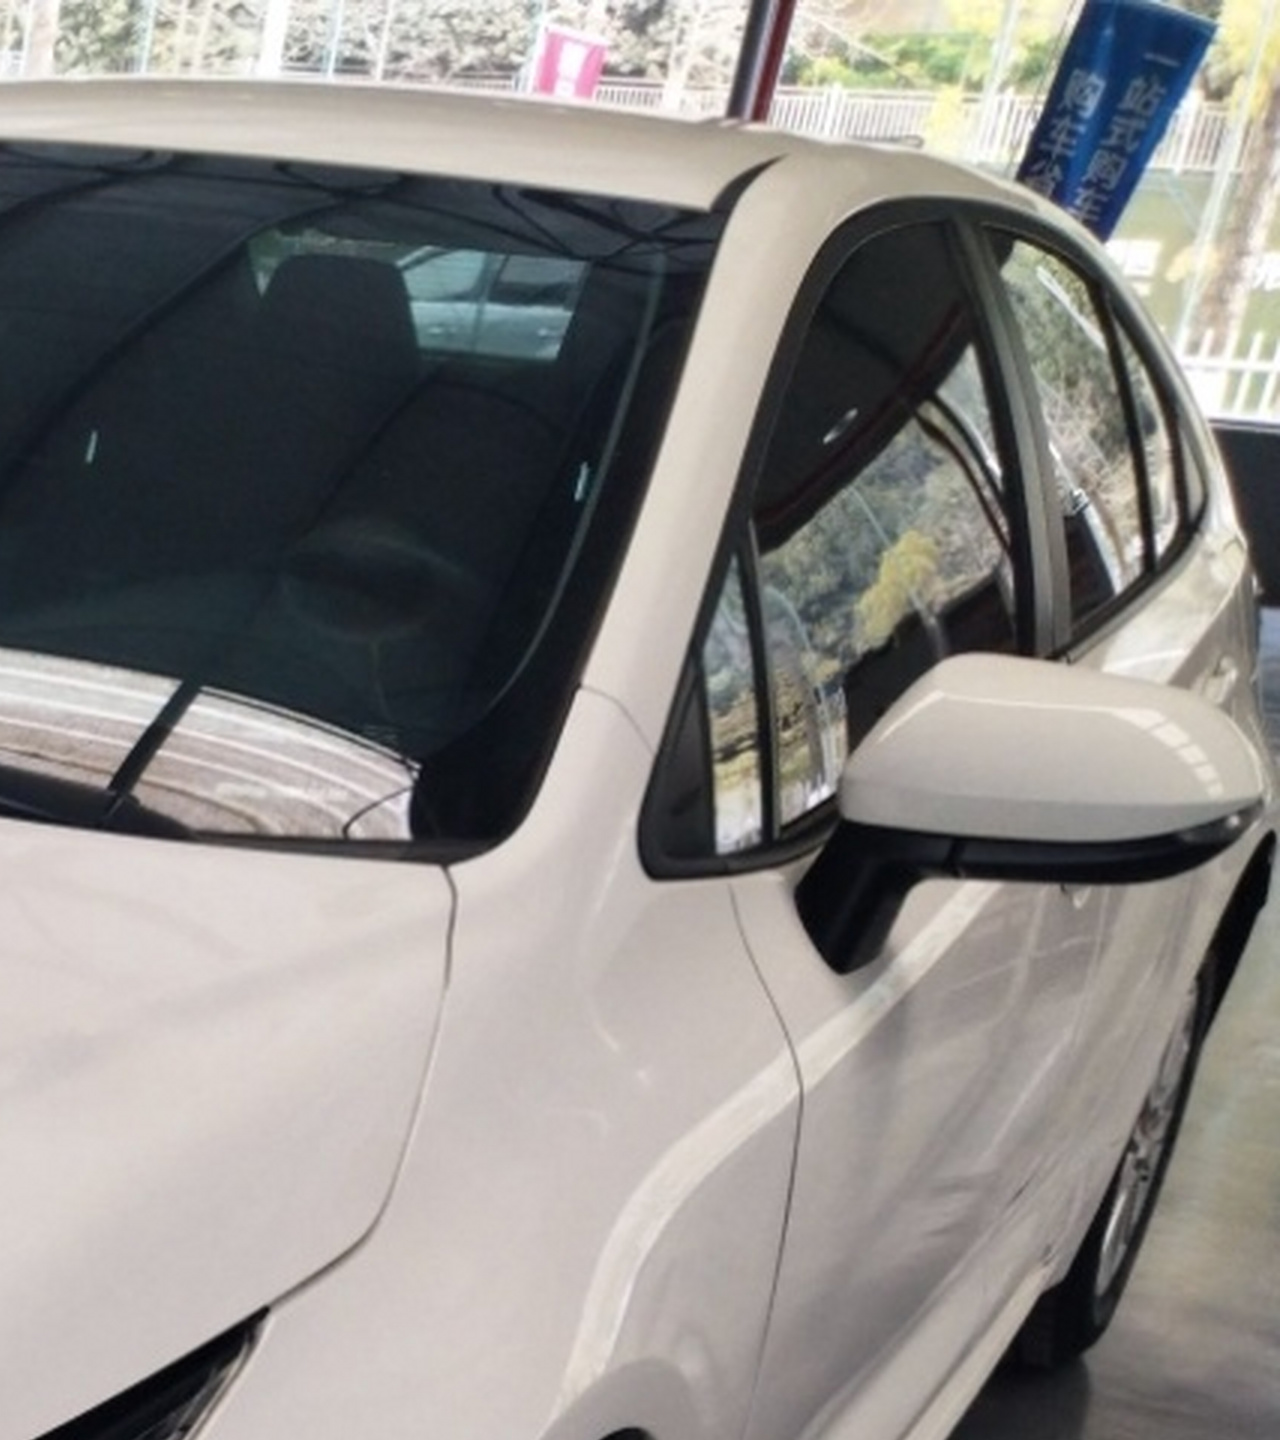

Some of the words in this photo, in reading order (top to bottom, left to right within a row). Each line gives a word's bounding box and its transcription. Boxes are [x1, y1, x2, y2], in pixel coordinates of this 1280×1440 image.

[1066, 52, 1181, 224] 一站式购车
